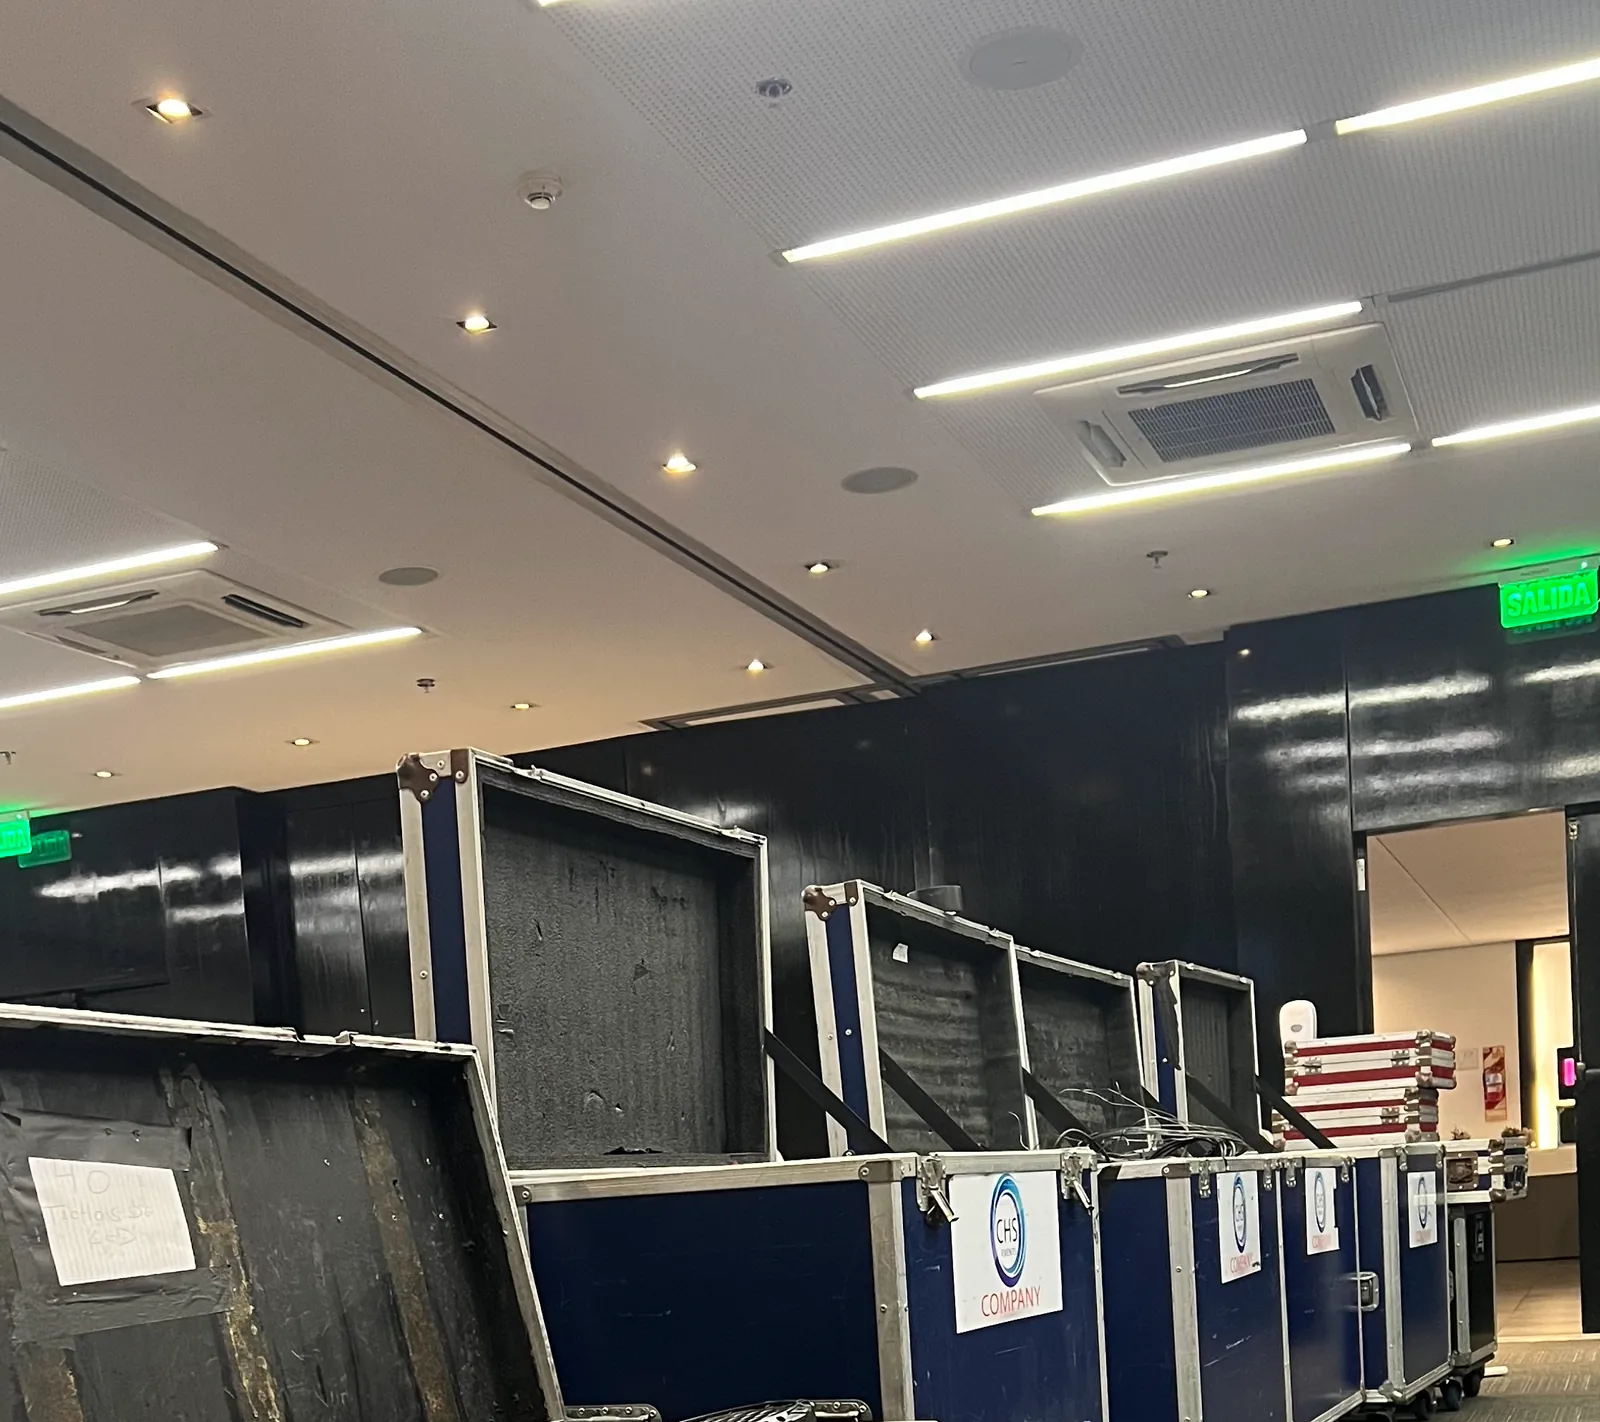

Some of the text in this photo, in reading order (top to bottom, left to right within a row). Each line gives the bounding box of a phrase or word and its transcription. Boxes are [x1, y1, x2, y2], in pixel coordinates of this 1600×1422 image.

[1507, 582, 1591, 617] SALIDA
[996, 1217, 1018, 1243] CHS
[981, 1285, 1042, 1317] COMPANY
